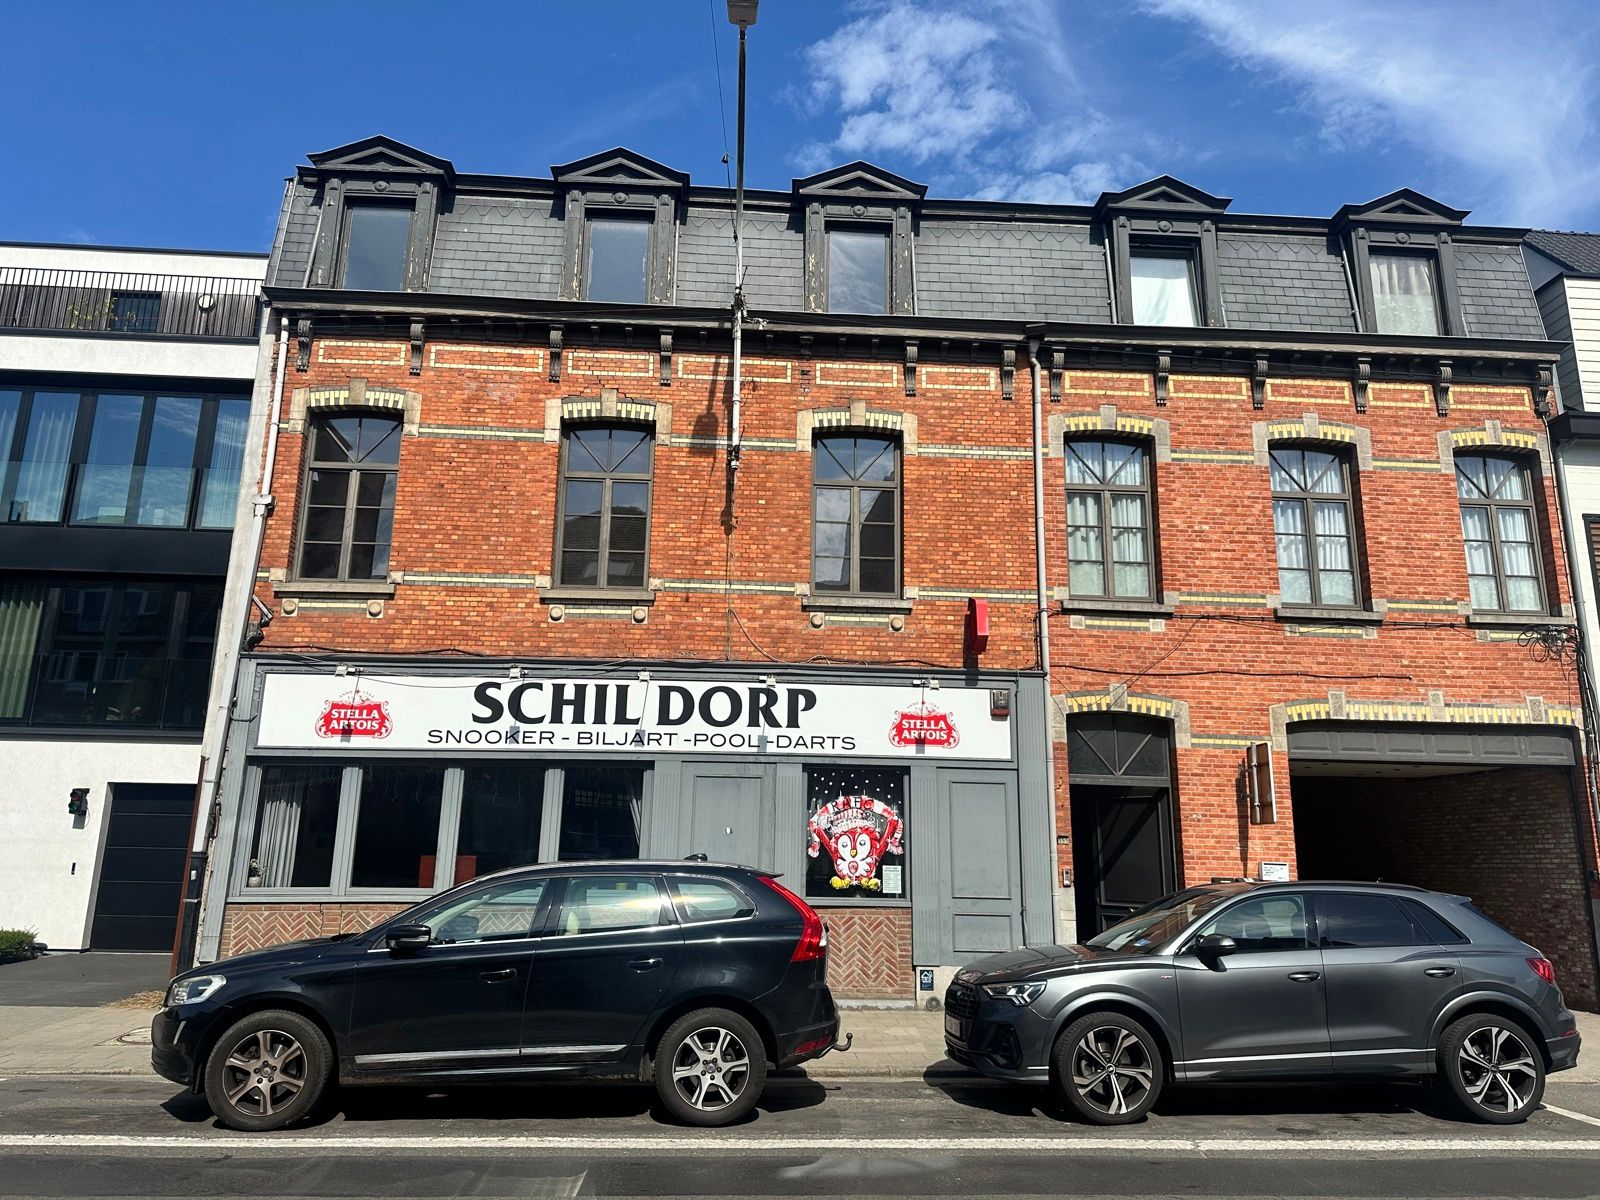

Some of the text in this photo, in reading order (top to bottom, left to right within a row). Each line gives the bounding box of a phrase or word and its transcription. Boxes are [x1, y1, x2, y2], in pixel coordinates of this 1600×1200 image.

[331, 709, 380, 719] STELLA
[329, 719, 379, 730] ARTOIS
[902, 719, 947, 730] STELLA
[427, 729, 555, 745] SNOOKER
[577, 731, 678, 746] BILJART
[901, 729, 948, 740] ARTOIS
